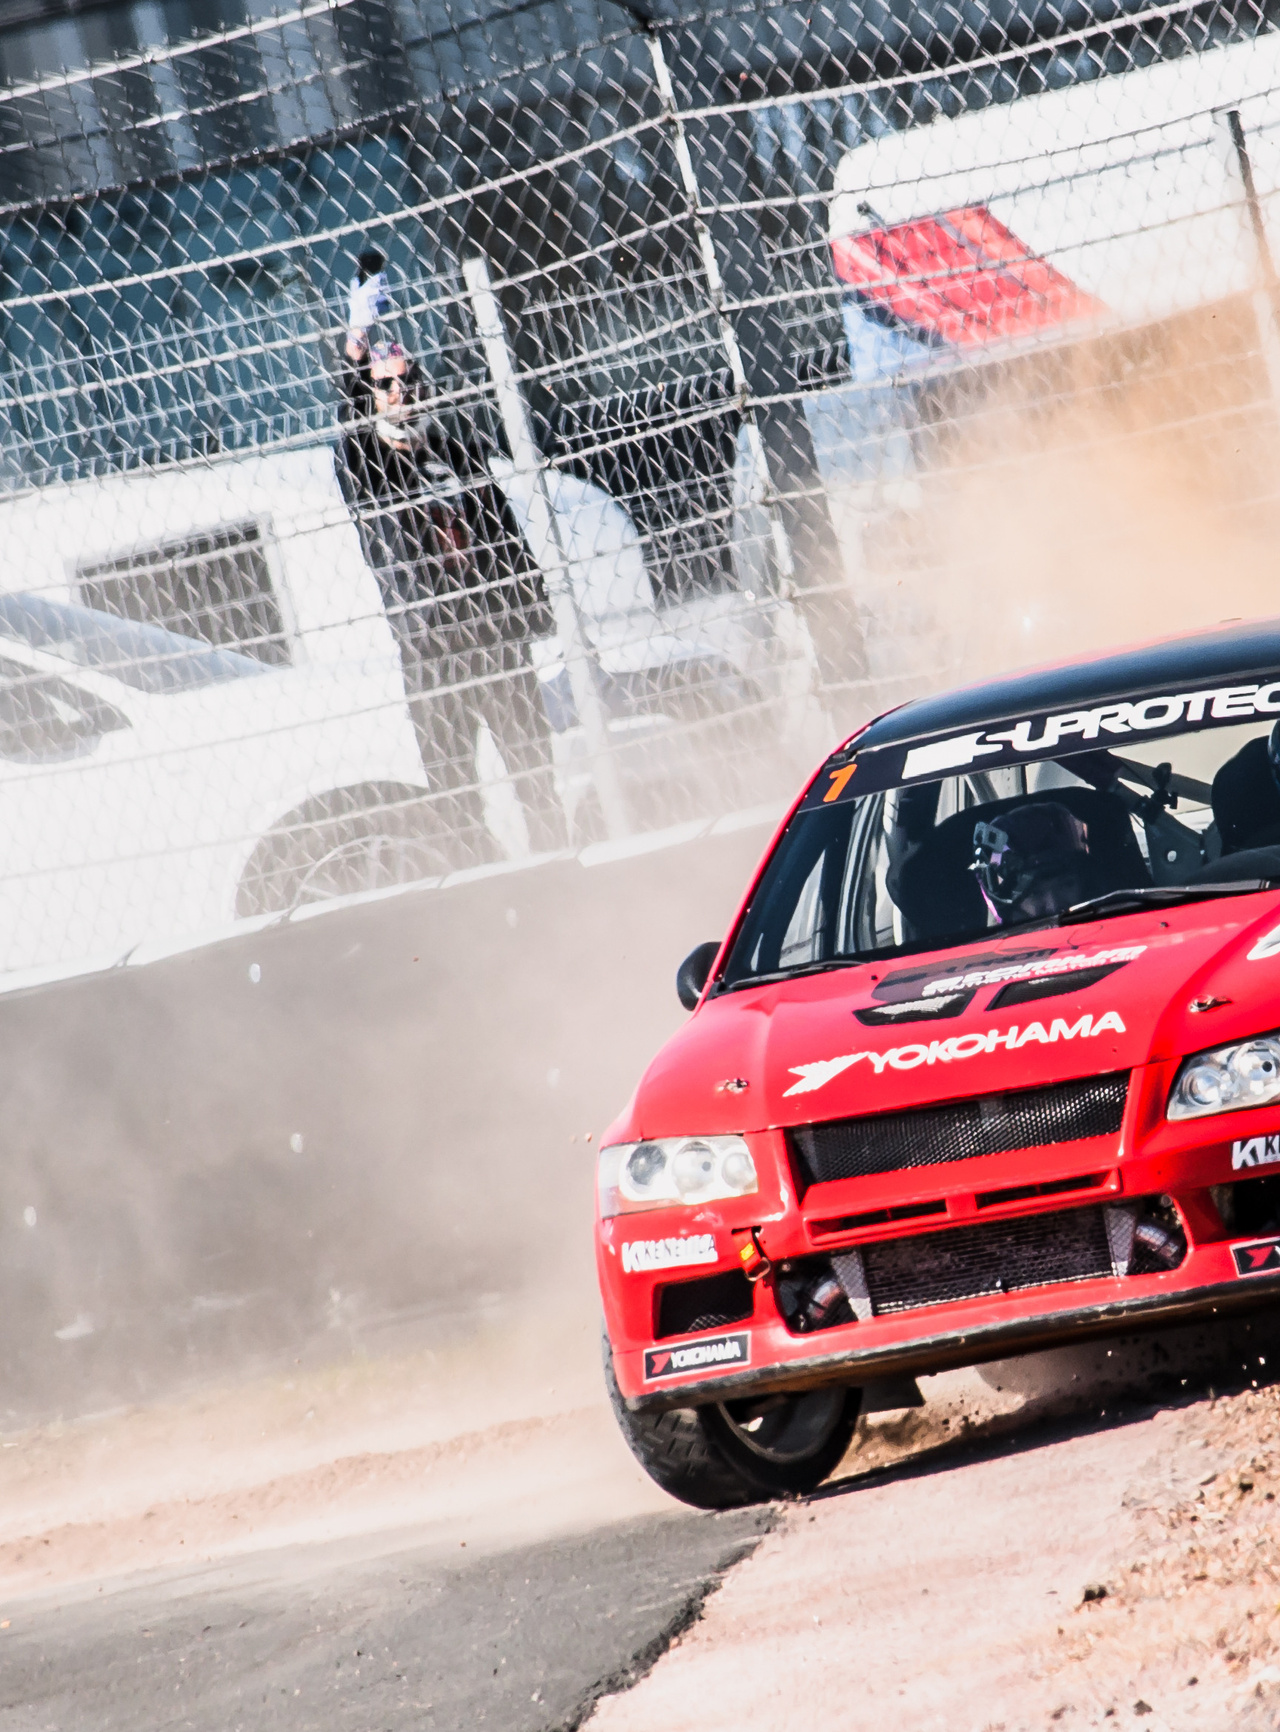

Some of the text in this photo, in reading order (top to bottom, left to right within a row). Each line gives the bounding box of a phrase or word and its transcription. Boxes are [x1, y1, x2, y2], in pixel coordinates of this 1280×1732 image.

[823, 764, 858, 803] 1
[867, 1011, 1127, 1074] YOKOHAMA
[670, 1341, 741, 1368] YOKOHAMA
